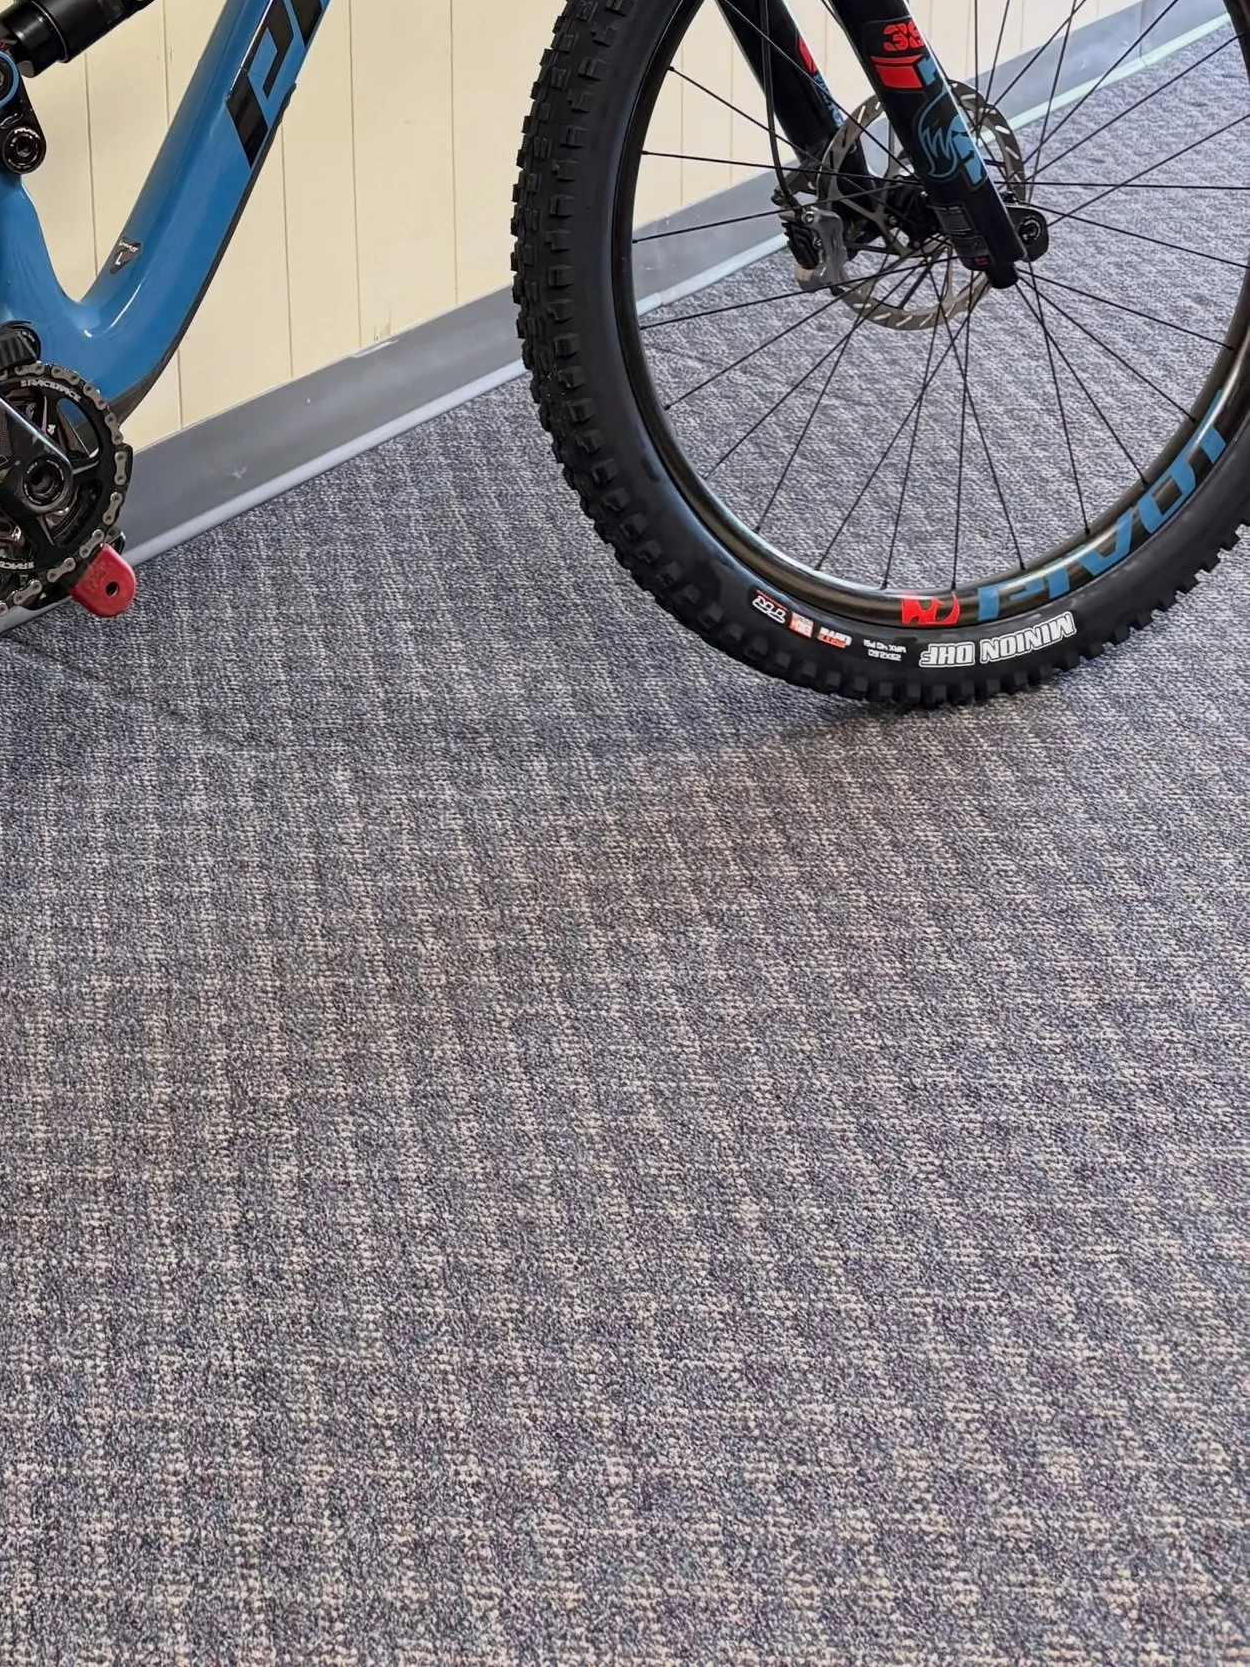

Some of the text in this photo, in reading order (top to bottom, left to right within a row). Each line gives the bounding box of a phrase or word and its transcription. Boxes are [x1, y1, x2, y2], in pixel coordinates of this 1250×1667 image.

[25, 378, 82, 403] RACEFACE
[977, 388, 1227, 622] PIVOT
[888, 643, 907, 654] MAX
[918, 610, 1078, 669] MINION DHF
